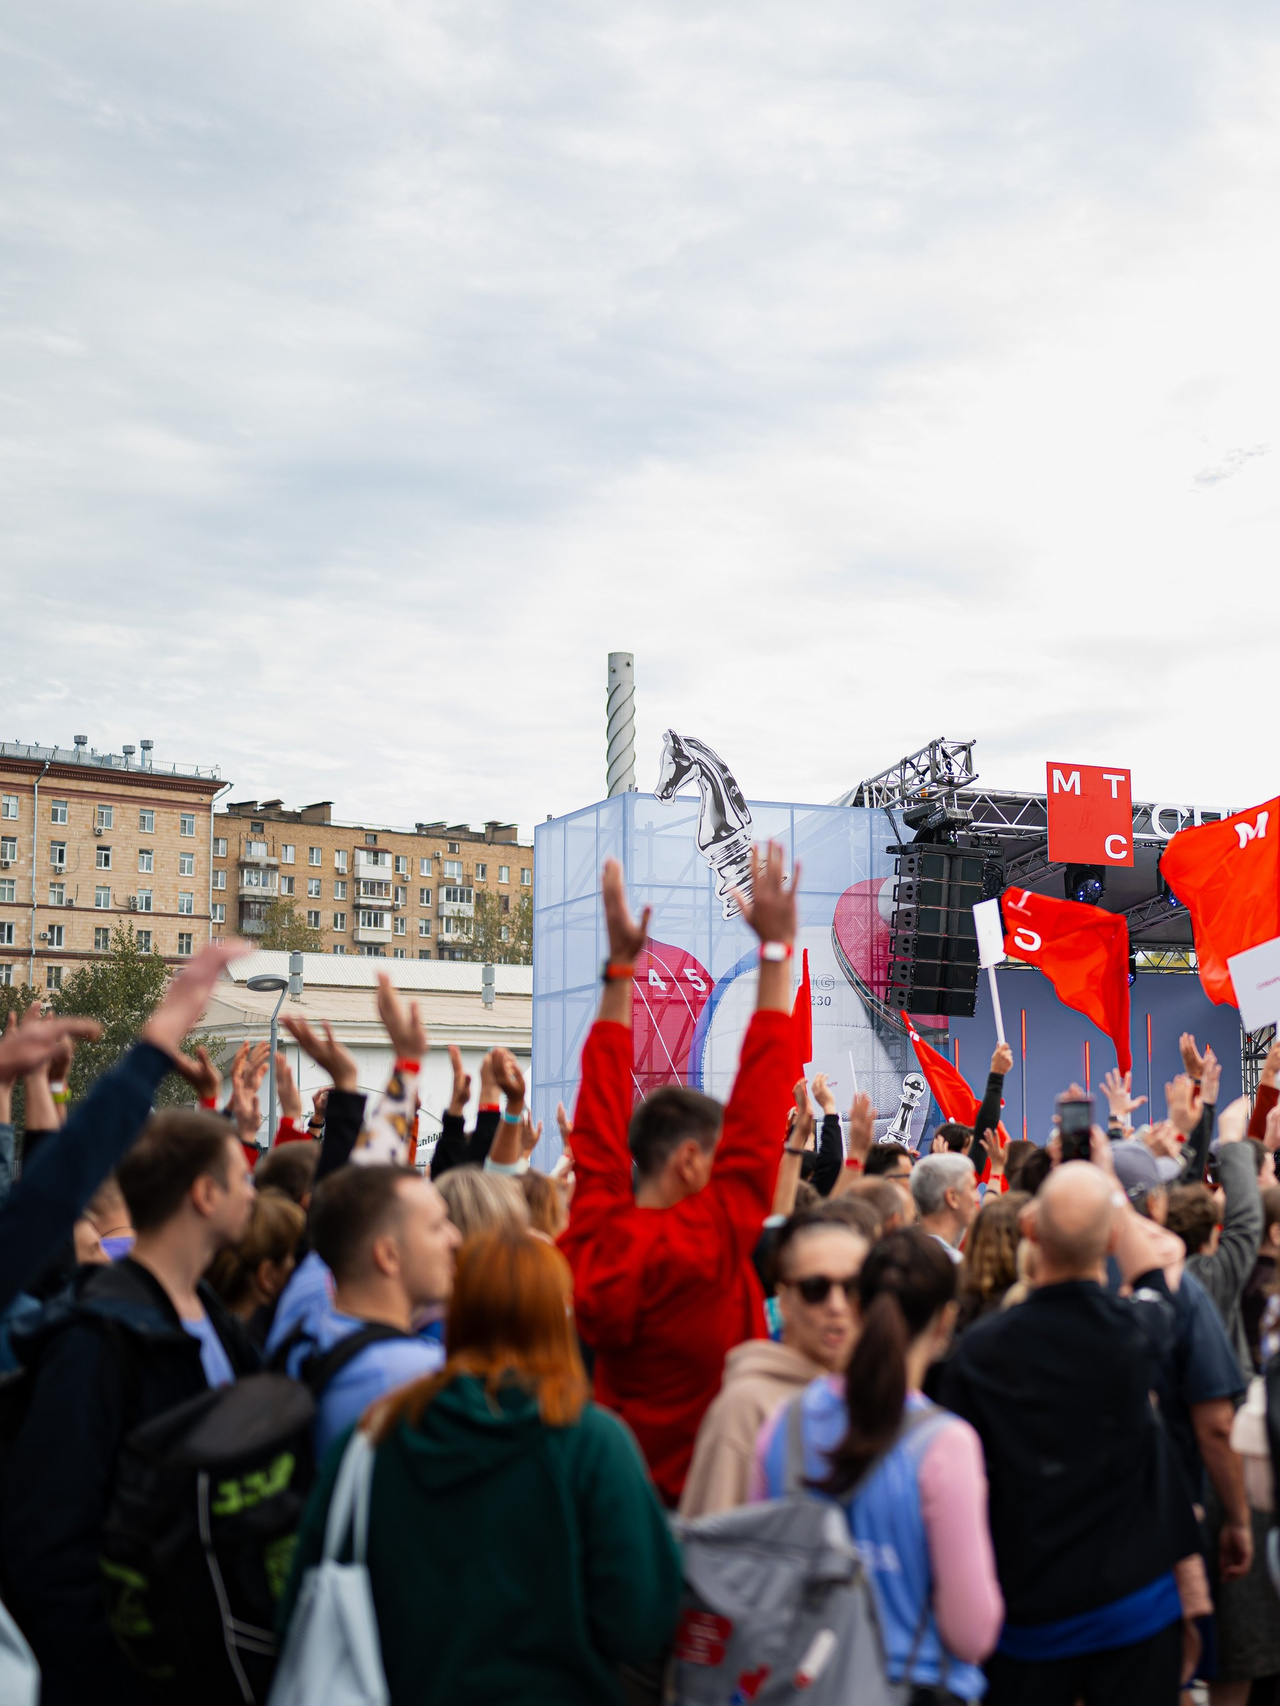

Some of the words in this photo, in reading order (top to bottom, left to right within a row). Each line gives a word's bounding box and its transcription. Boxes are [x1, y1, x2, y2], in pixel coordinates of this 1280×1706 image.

[1052, 769, 1081, 795] М
[1102, 773, 1125, 799] Т
[1234, 811, 1269, 849] М
[1104, 834, 1128, 860] С
[648, 968, 667, 990] 4
[683, 968, 707, 992] 5
